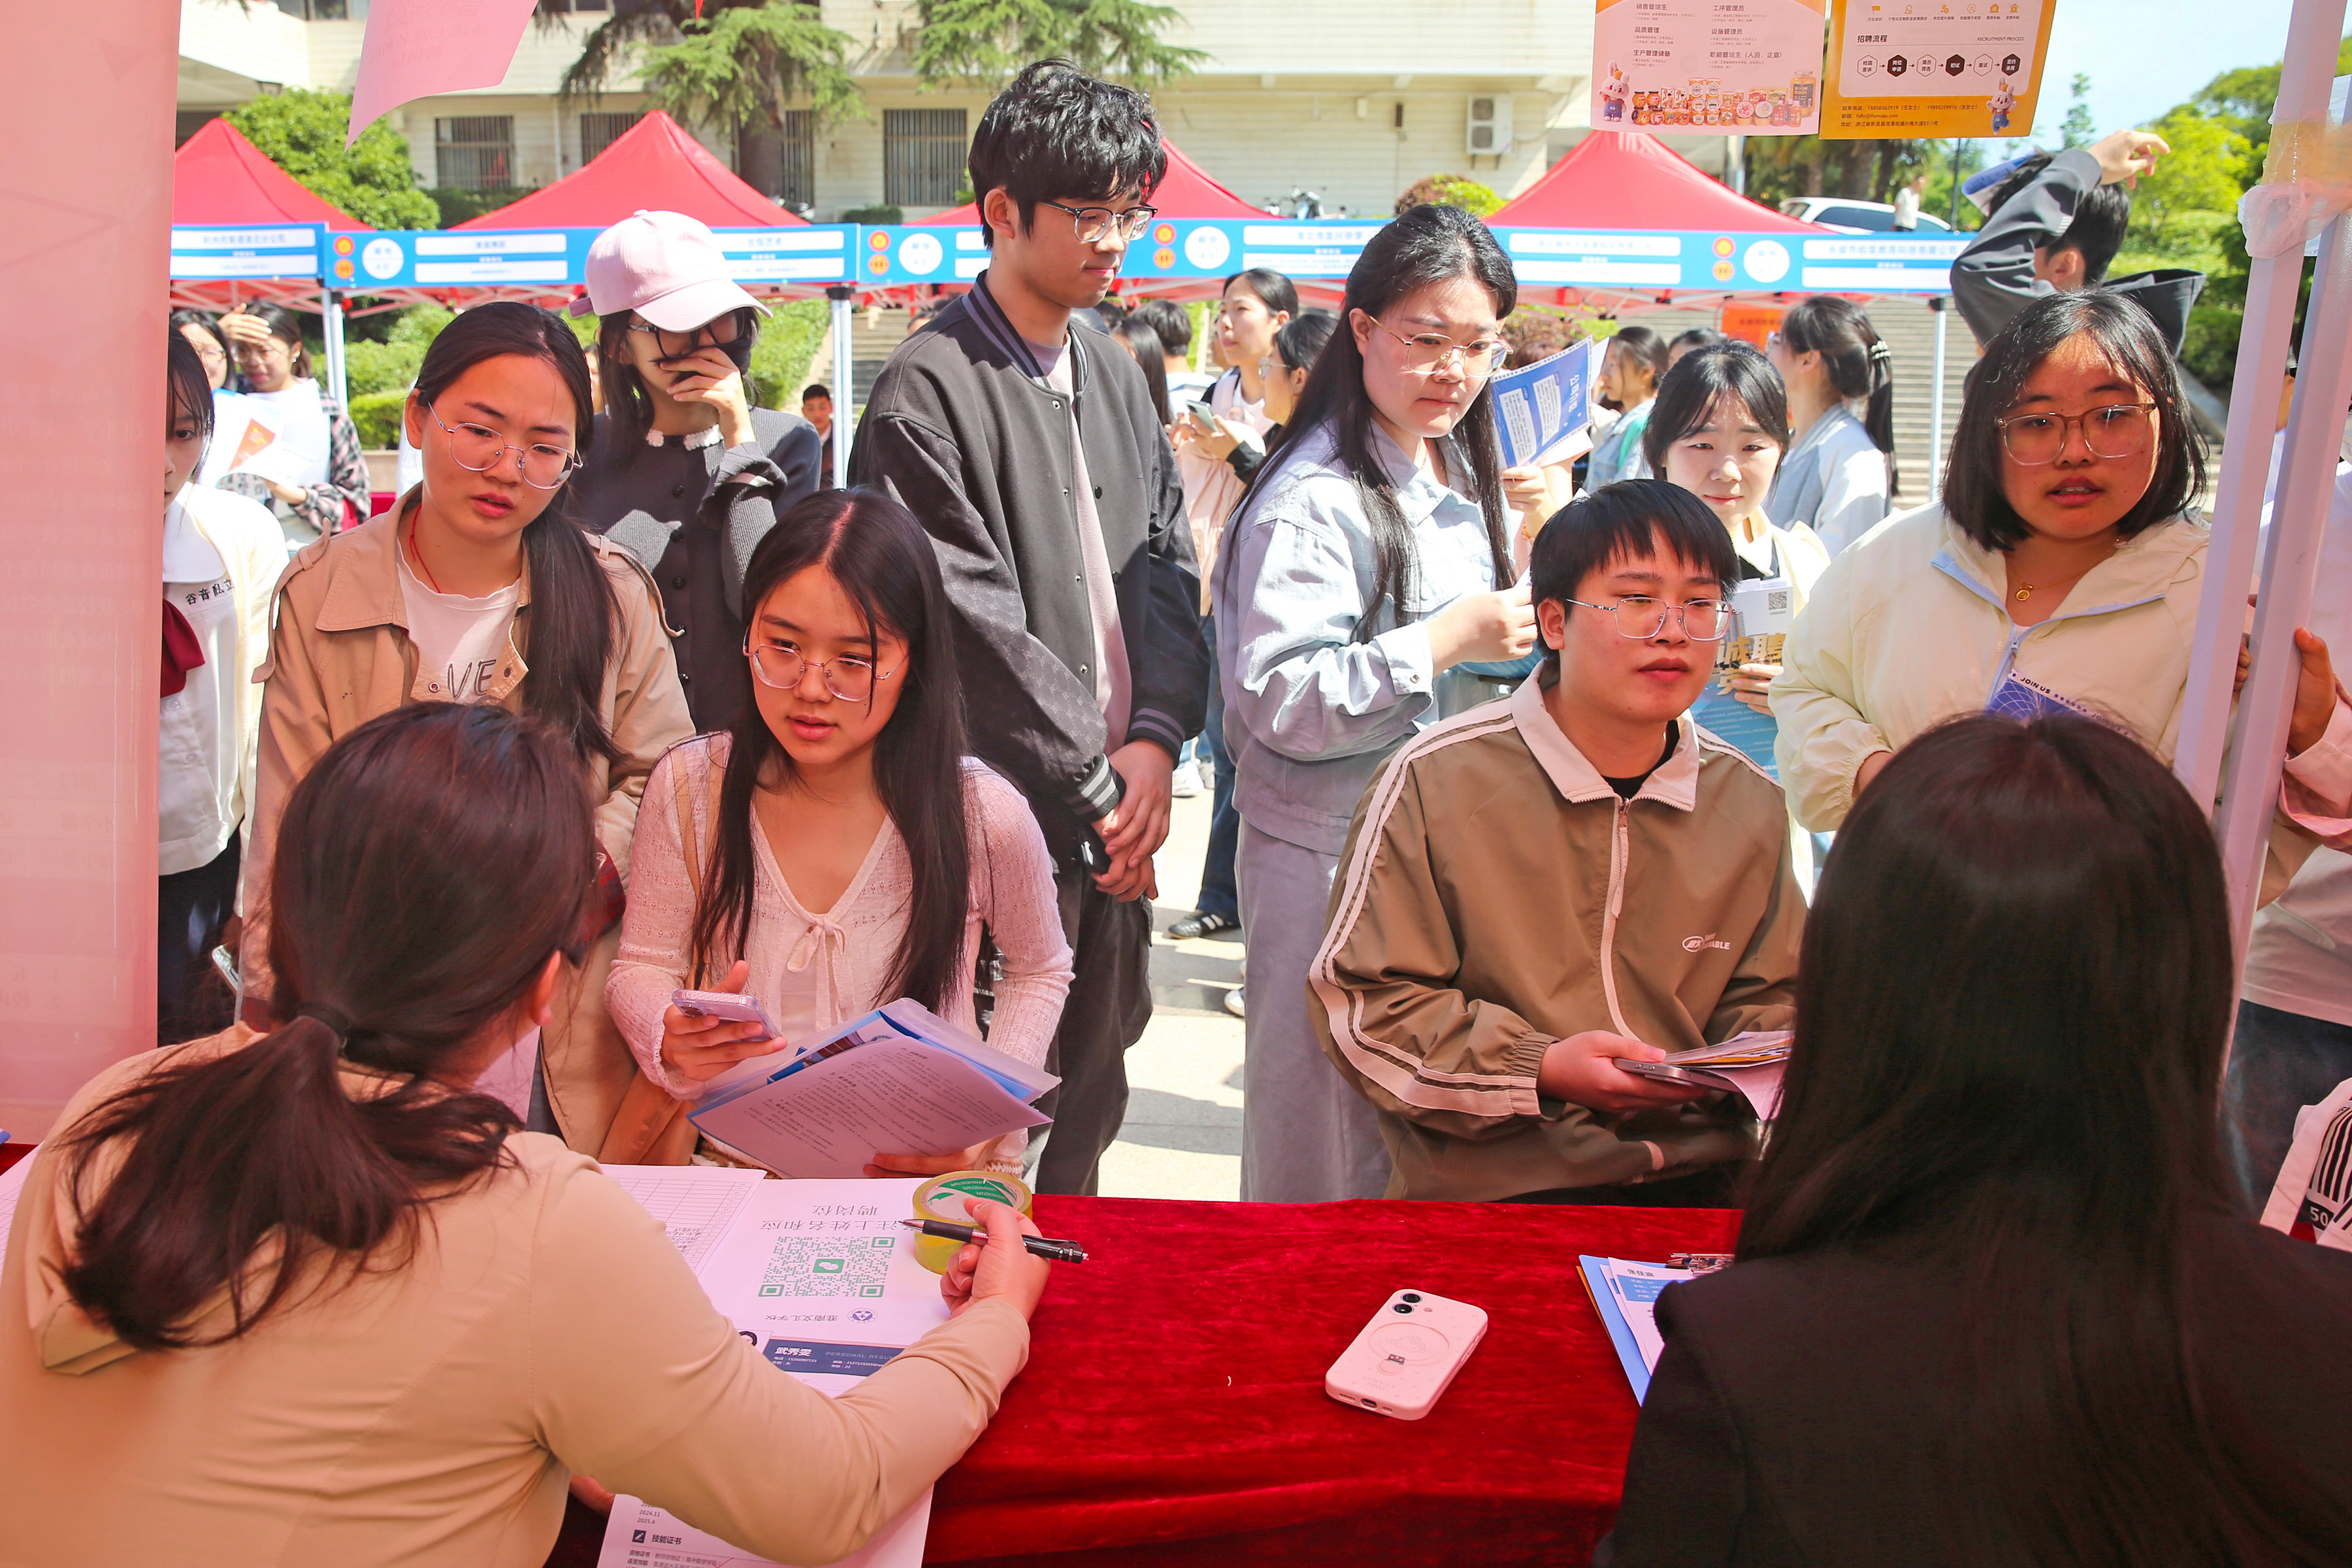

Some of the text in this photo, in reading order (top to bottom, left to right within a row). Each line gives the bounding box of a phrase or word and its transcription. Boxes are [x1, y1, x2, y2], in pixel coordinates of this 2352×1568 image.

[1857, 35, 1887, 43] 招聘流程
[186, 578, 235, 606] 谷音私立
[2020, 676, 2051, 694] JOIN US
[812, 1205, 879, 1216] 聘岗位
[2310, 1206, 2329, 1227] 50
[775, 1347, 812, 1357] 武秀雯
[651, 1534, 681, 1545] 技能证书
